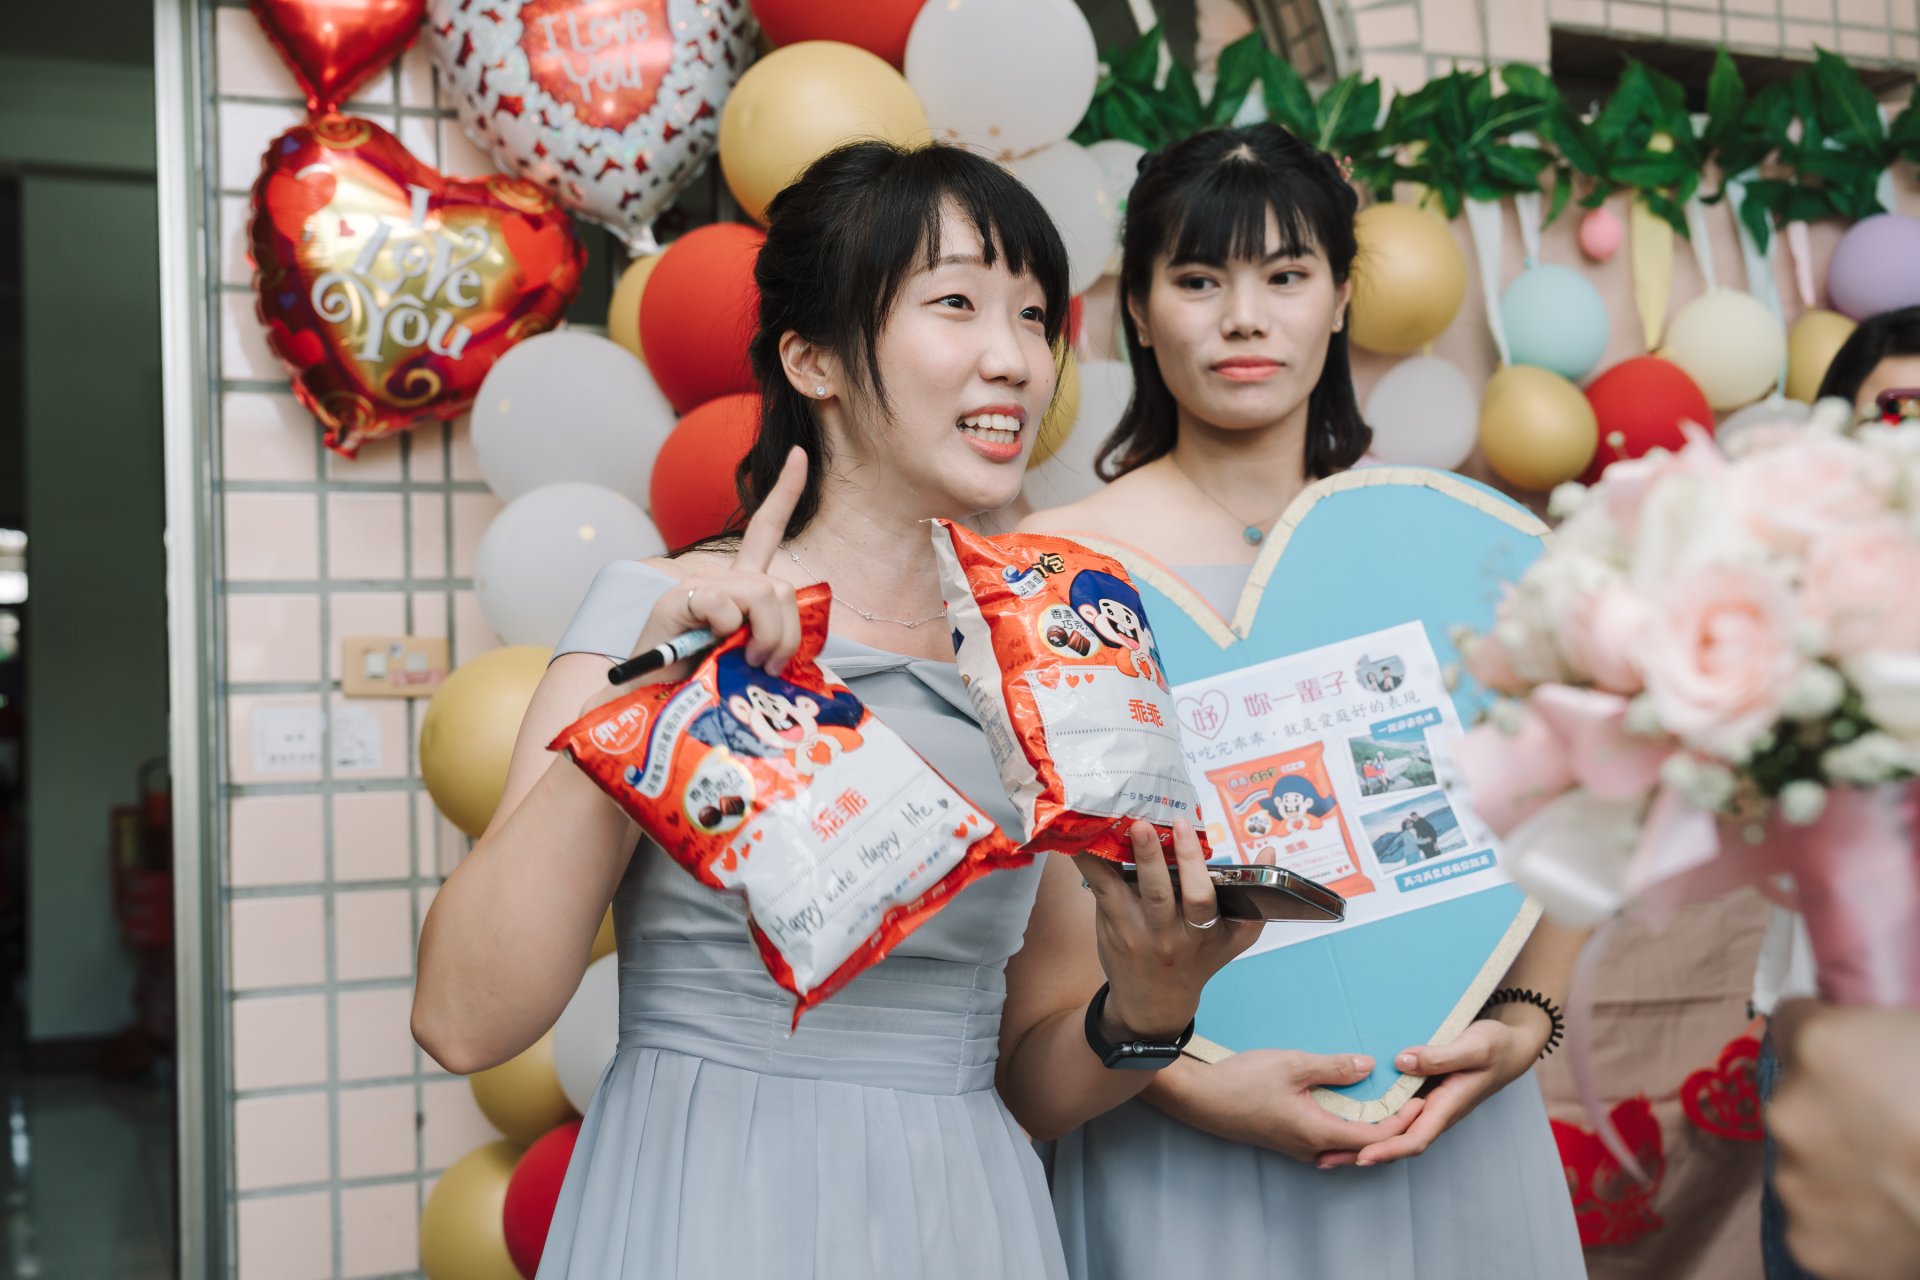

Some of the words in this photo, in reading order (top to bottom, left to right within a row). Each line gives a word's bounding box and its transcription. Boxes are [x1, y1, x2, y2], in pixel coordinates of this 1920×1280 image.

[536, 13, 565, 59] I
[567, 8, 650, 54] Love
[561, 53, 644, 104] You
[406, 184, 434, 229] I
[311, 271, 474, 362] You
[1061, 620, 1088, 631] 巧克
[1128, 699, 1164, 728] 乖乖
[771, 898, 825, 943] Happy
[857, 829, 900, 867] Happy
[902, 802, 934, 828] life
